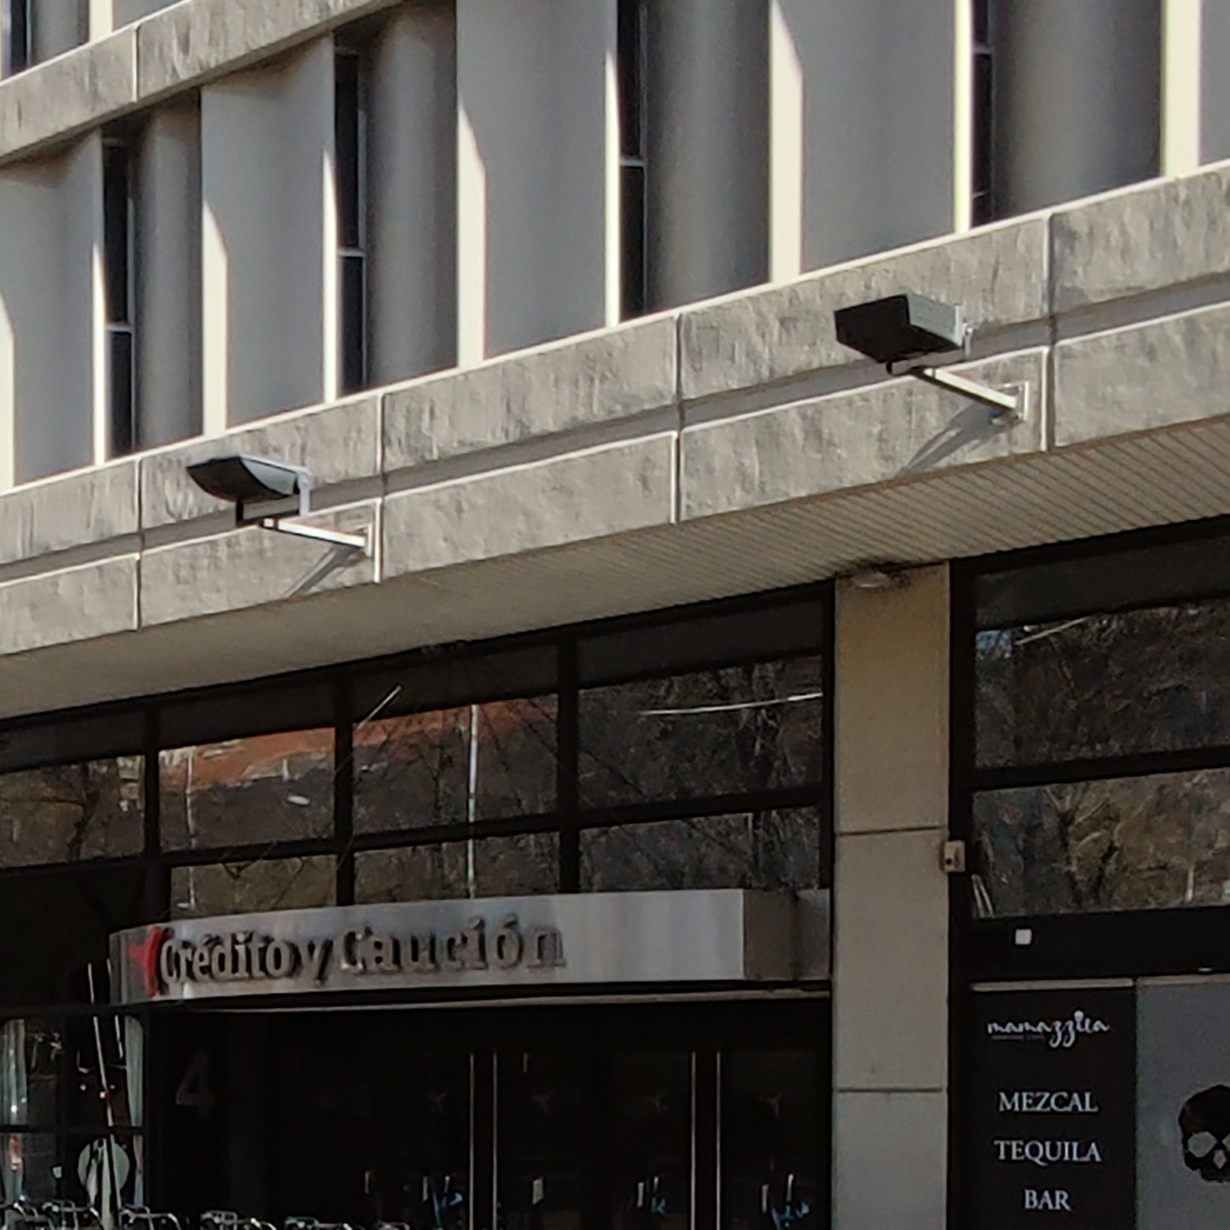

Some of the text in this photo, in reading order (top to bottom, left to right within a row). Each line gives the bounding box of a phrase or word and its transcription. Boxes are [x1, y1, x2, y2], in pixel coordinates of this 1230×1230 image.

[160, 913, 567, 986] Crédito y Caución
[998, 1091, 1099, 1112] MEZCAL
[993, 1139, 1102, 1167] TEQUILA
[1024, 1189, 1072, 1211] BAR
